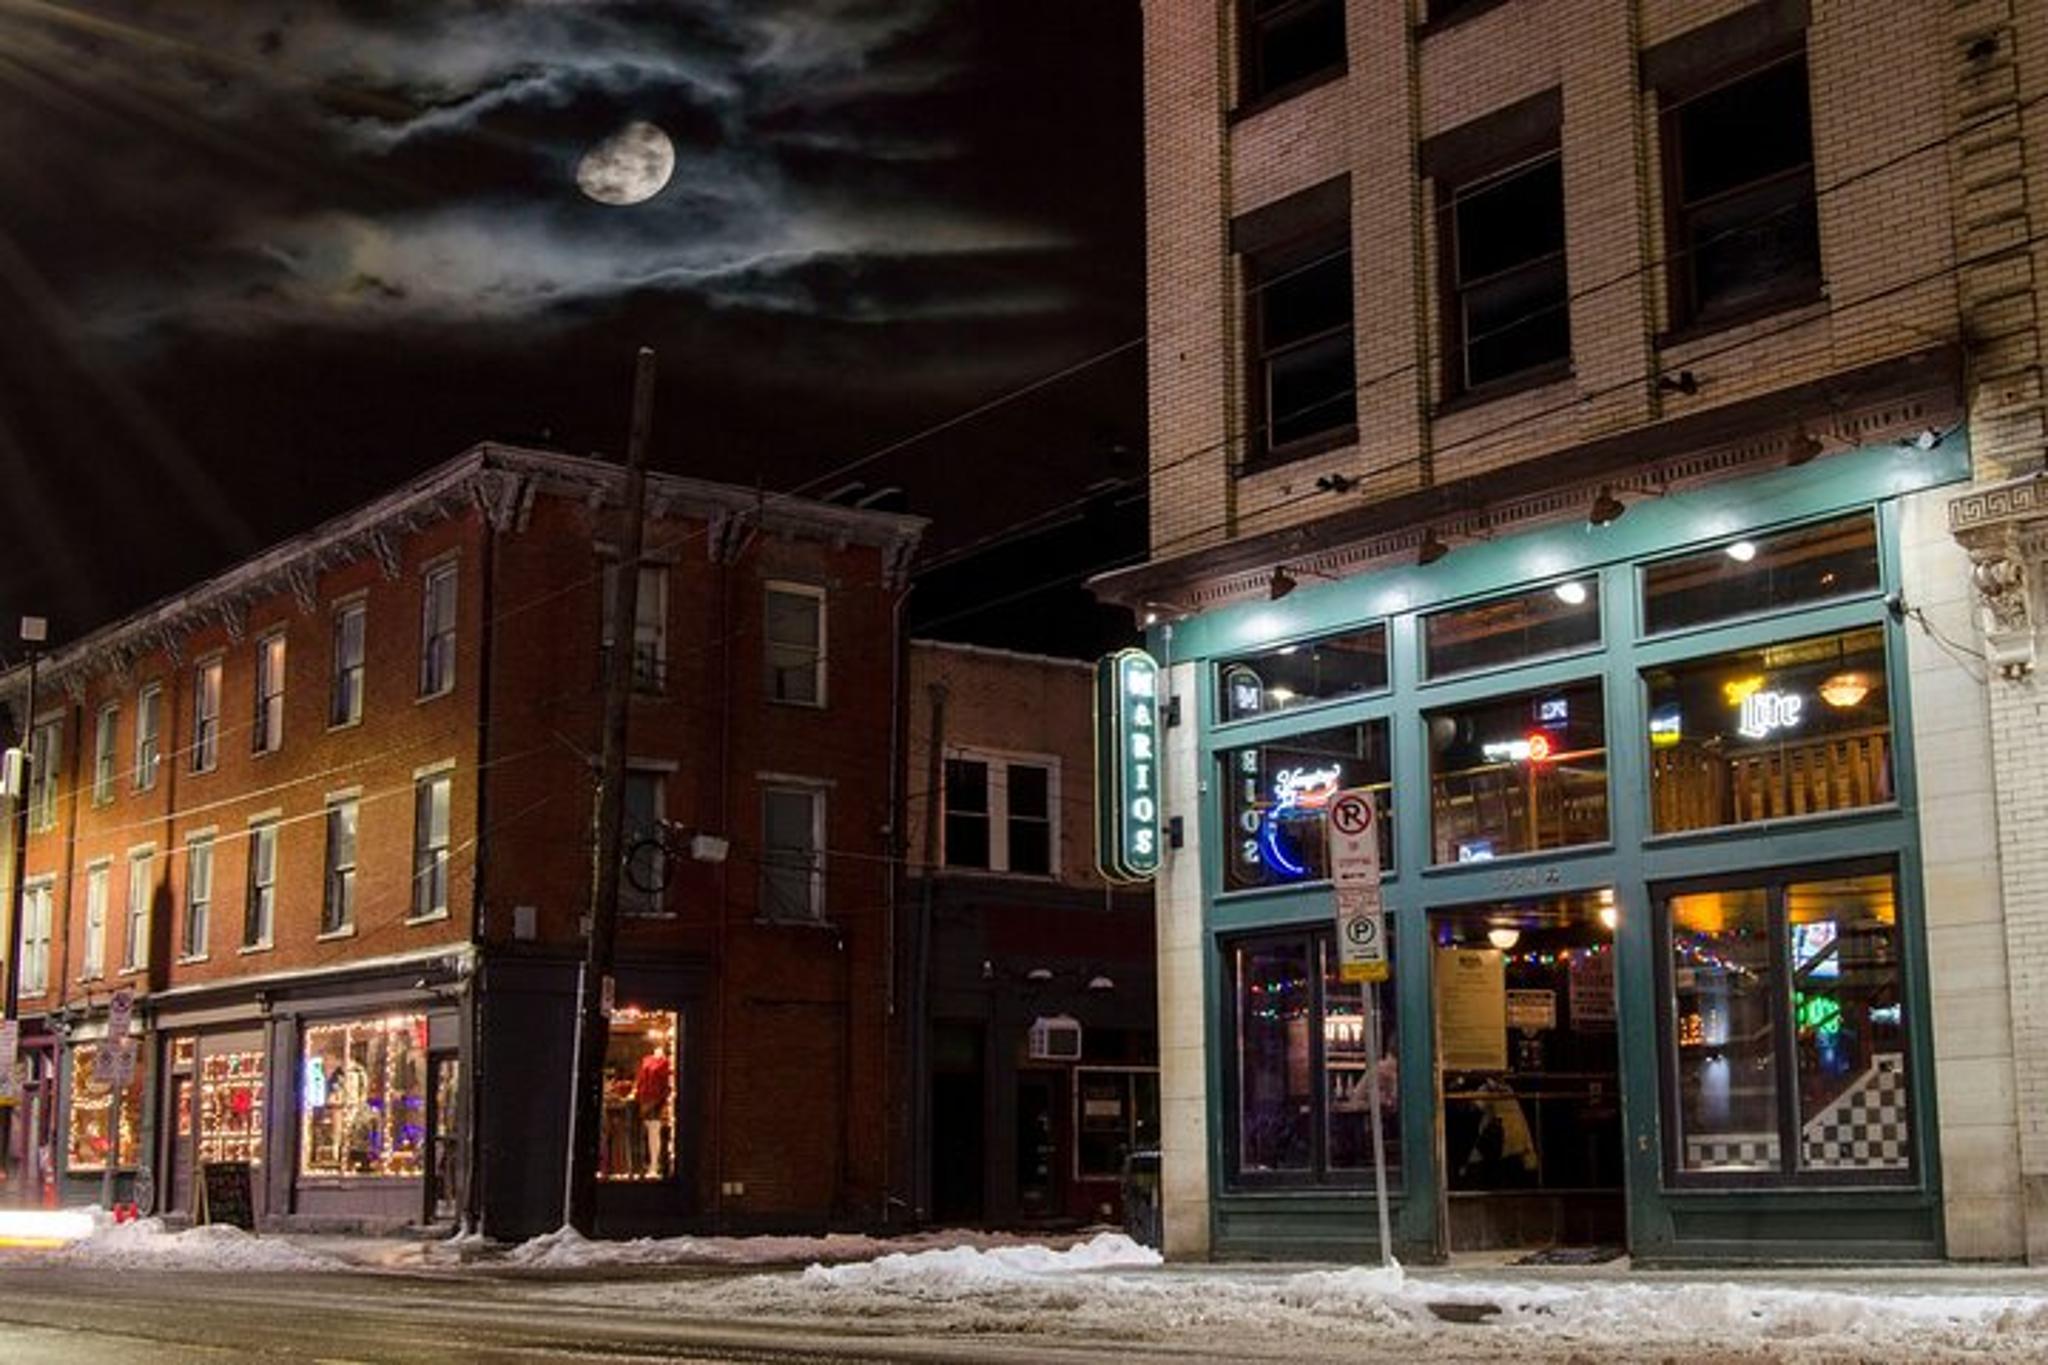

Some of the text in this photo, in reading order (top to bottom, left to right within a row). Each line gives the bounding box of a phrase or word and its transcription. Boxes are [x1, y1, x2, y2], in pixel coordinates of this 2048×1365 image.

[1738, 691, 1802, 739] Lite
[1127, 669, 1155, 857] MARIOS
[1355, 921, 1368, 939] P
